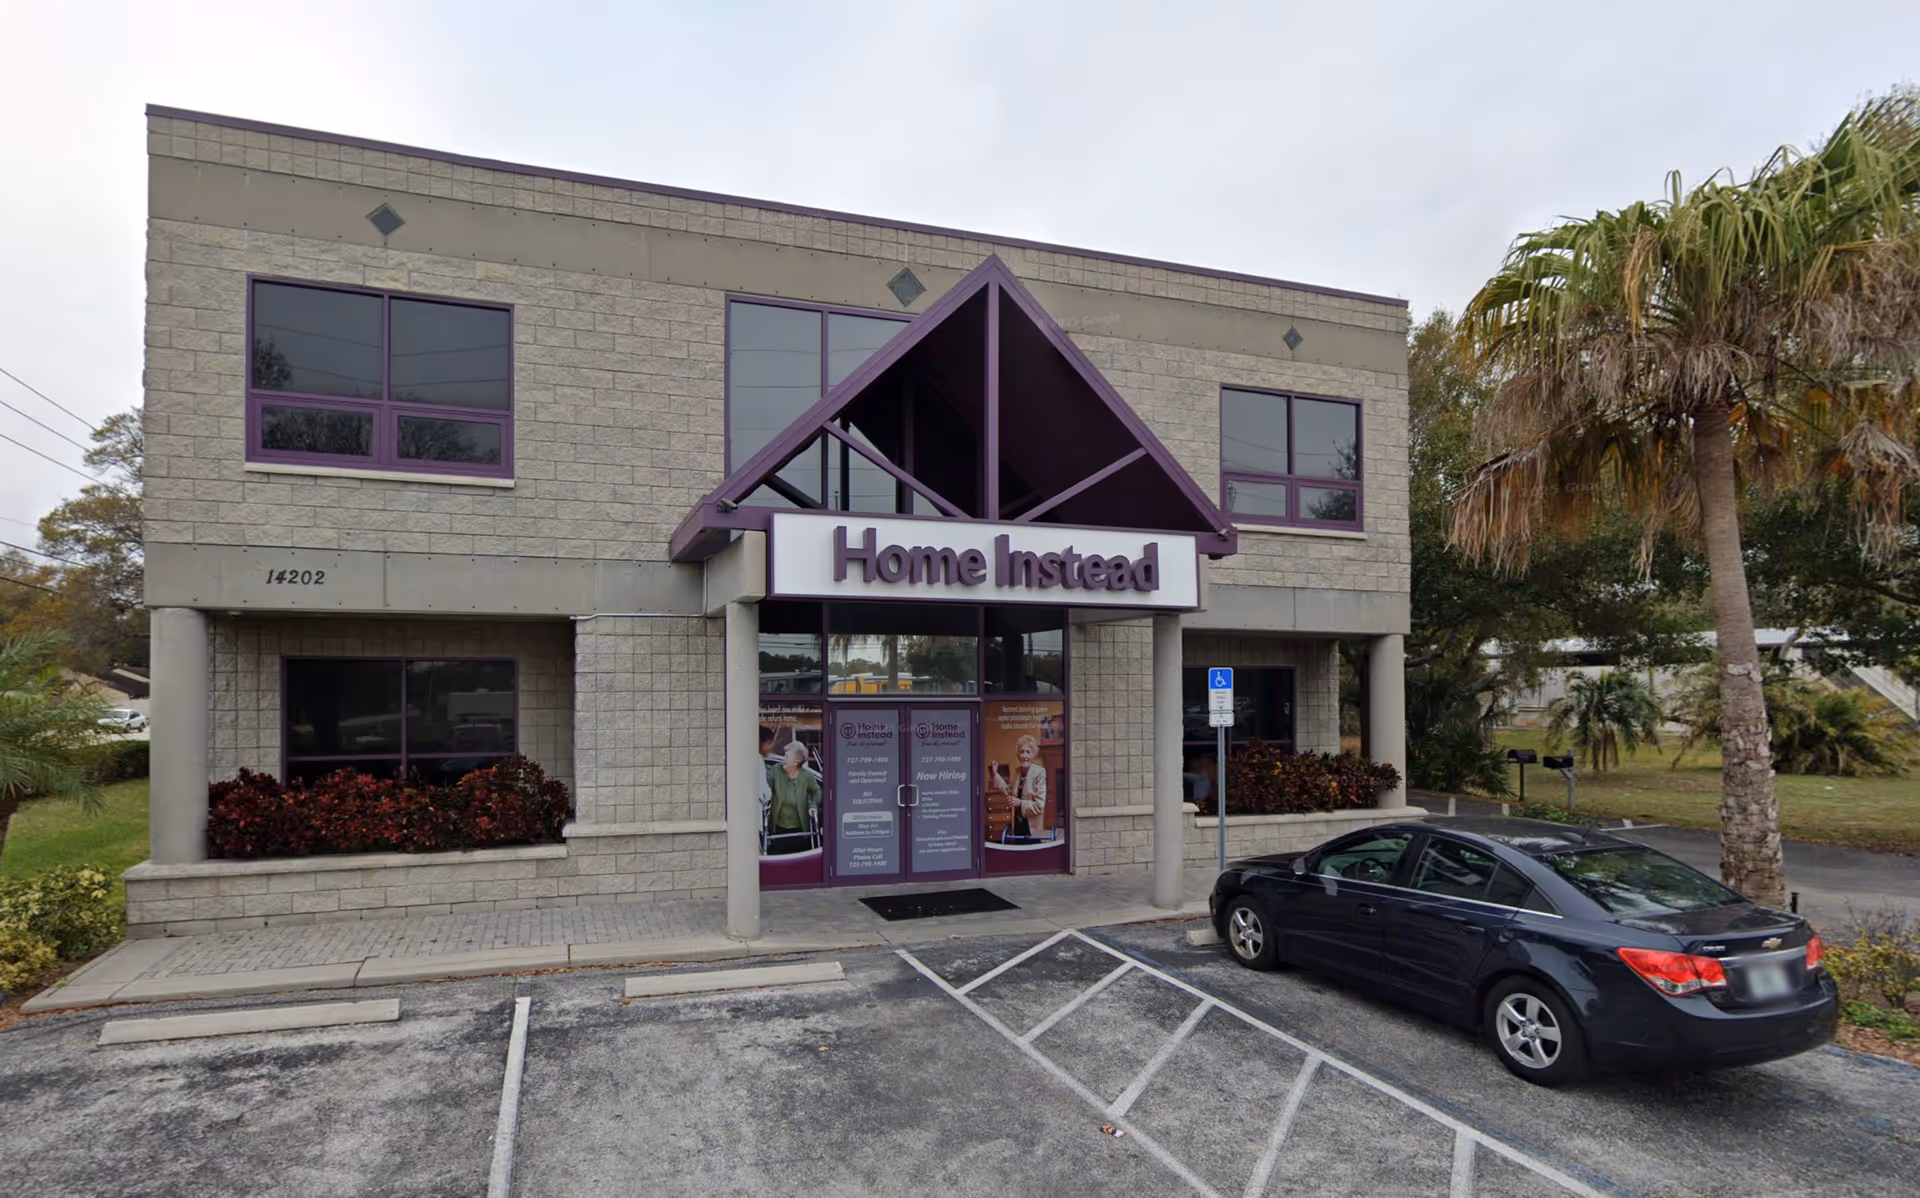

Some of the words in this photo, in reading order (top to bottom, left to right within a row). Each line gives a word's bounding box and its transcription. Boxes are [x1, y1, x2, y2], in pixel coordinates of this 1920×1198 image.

[833, 525, 987, 586] Home
[994, 533, 1160, 592] Instead
[266, 569, 325, 585] 14202
[857, 722, 886, 731] Home
[931, 722, 959, 731] Home
[857, 731, 893, 739] Instead
[916, 771, 938, 781] Now
[938, 769, 967, 782] Hiring
